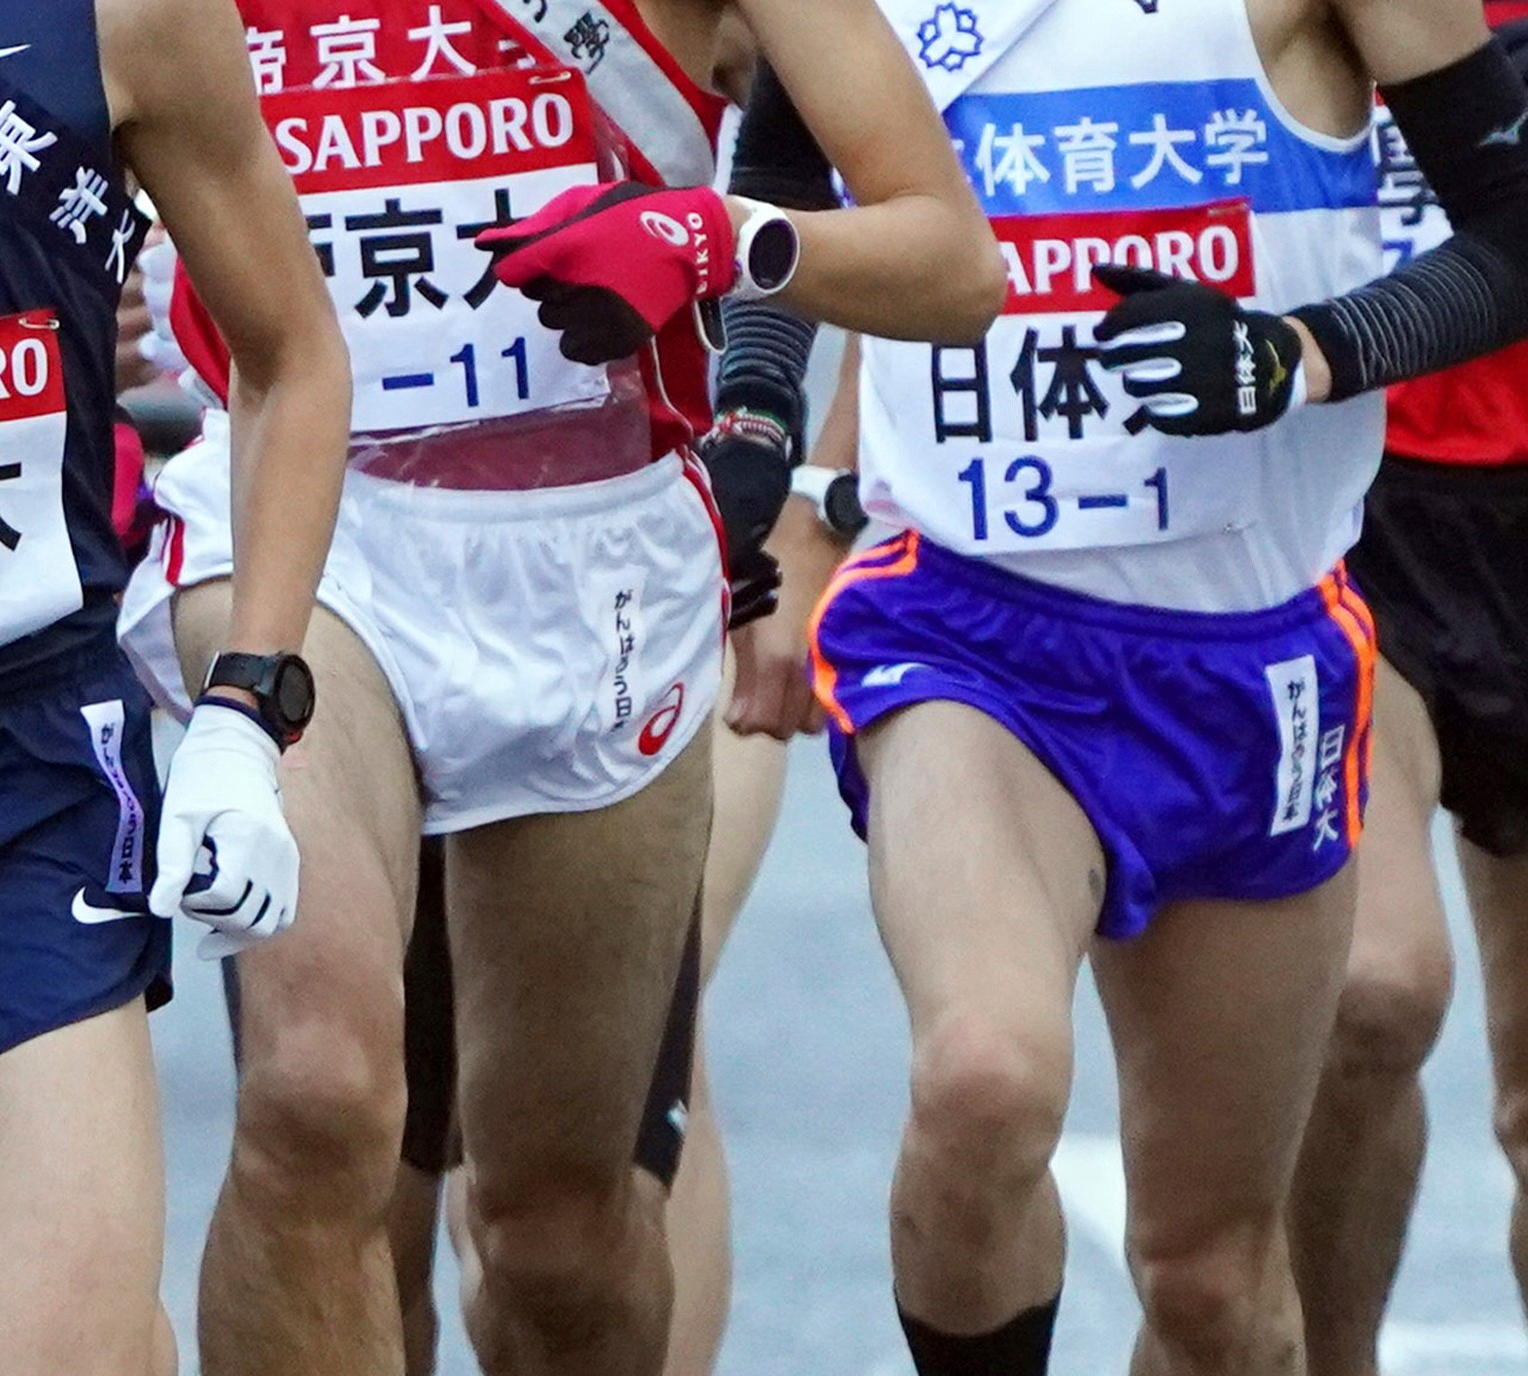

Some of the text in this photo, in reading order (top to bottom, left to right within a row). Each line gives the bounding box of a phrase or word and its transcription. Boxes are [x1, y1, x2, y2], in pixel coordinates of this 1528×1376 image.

[275, 93, 573, 175] SAPPORO
[948, 108, 1269, 197] 体育大学
[996, 225, 1240, 296] APPORO
[958, 455, 1169, 540] 13-1
